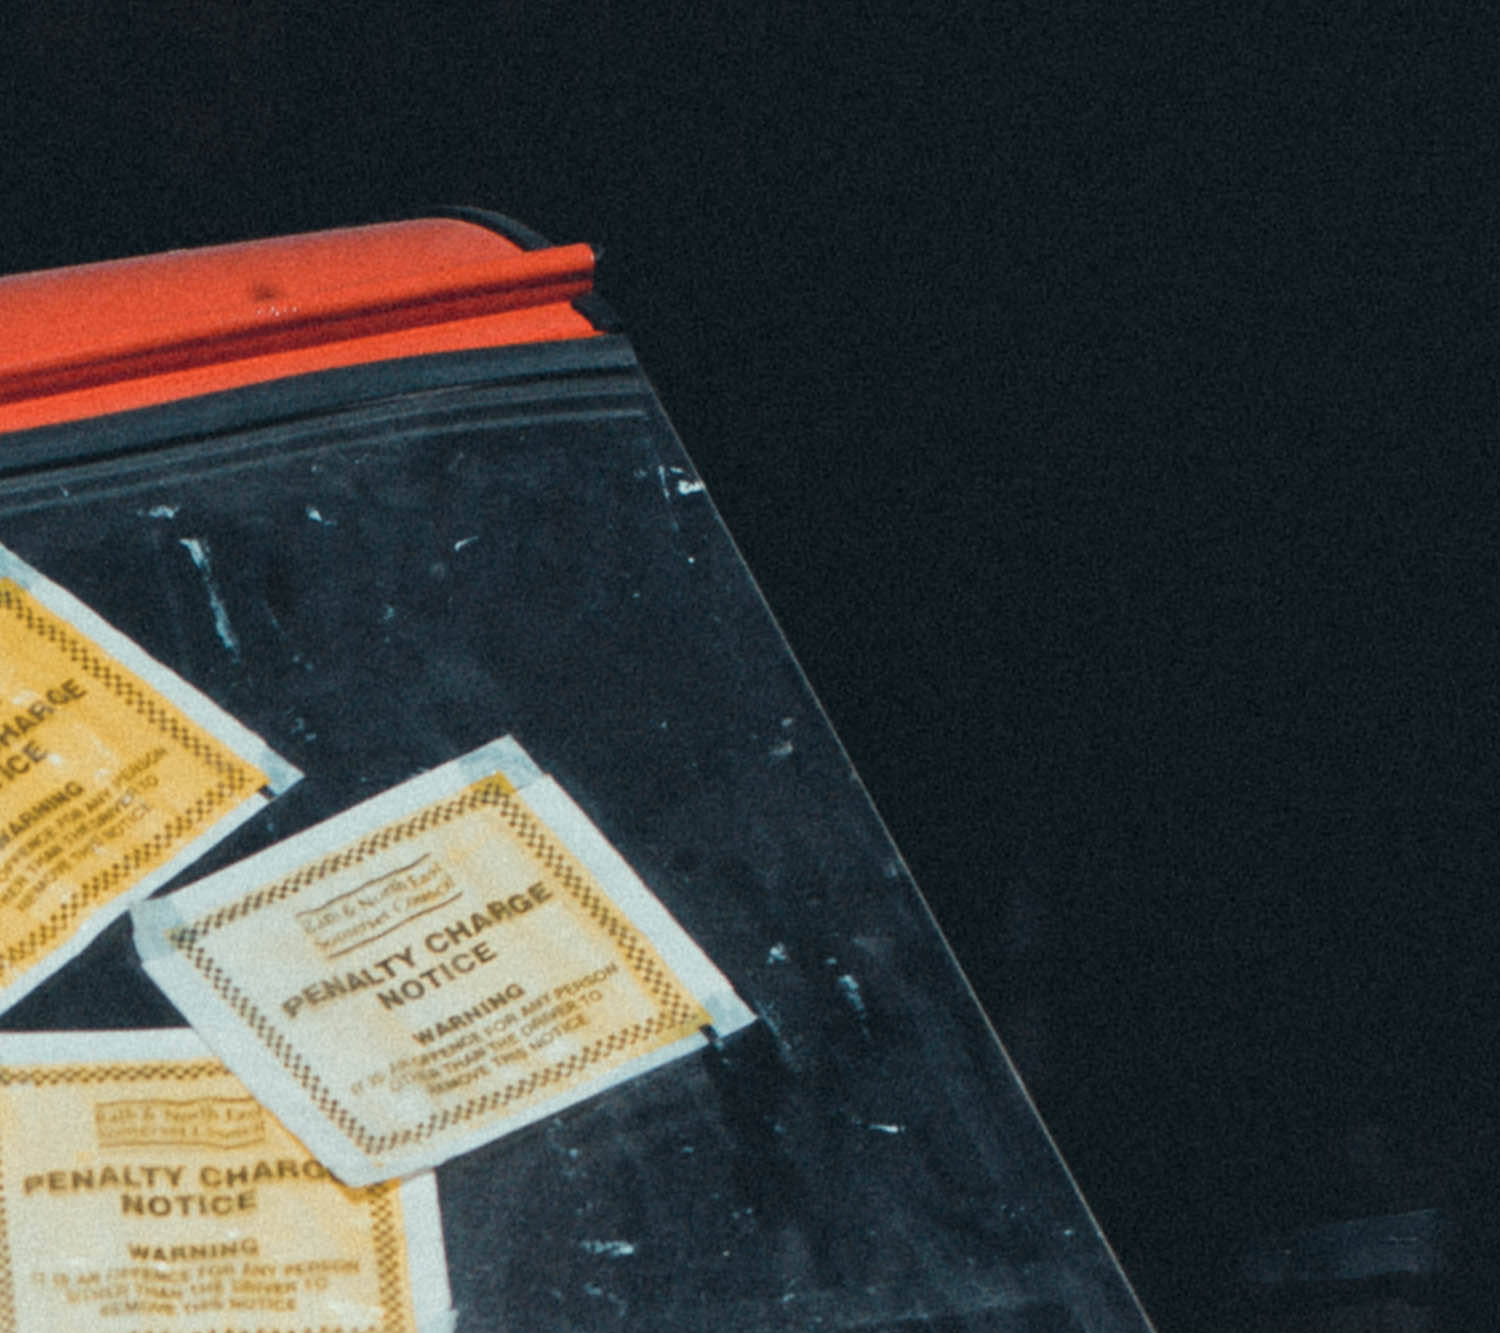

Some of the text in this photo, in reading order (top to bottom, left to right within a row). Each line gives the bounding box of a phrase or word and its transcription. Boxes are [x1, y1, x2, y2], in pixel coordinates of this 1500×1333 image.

[281, 881, 553, 1019] PENALTY CHARGE
[376, 941, 497, 1011] NOTICE
[553, 962, 619, 998] PERSON
[412, 983, 525, 1047] WARNING
[528, 1013, 589, 1051] NOTICE
[23, 1159, 333, 1196] PENALTY CHARG
[121, 1189, 257, 1218] NOTICE
[127, 1237, 259, 1262] WARNING
